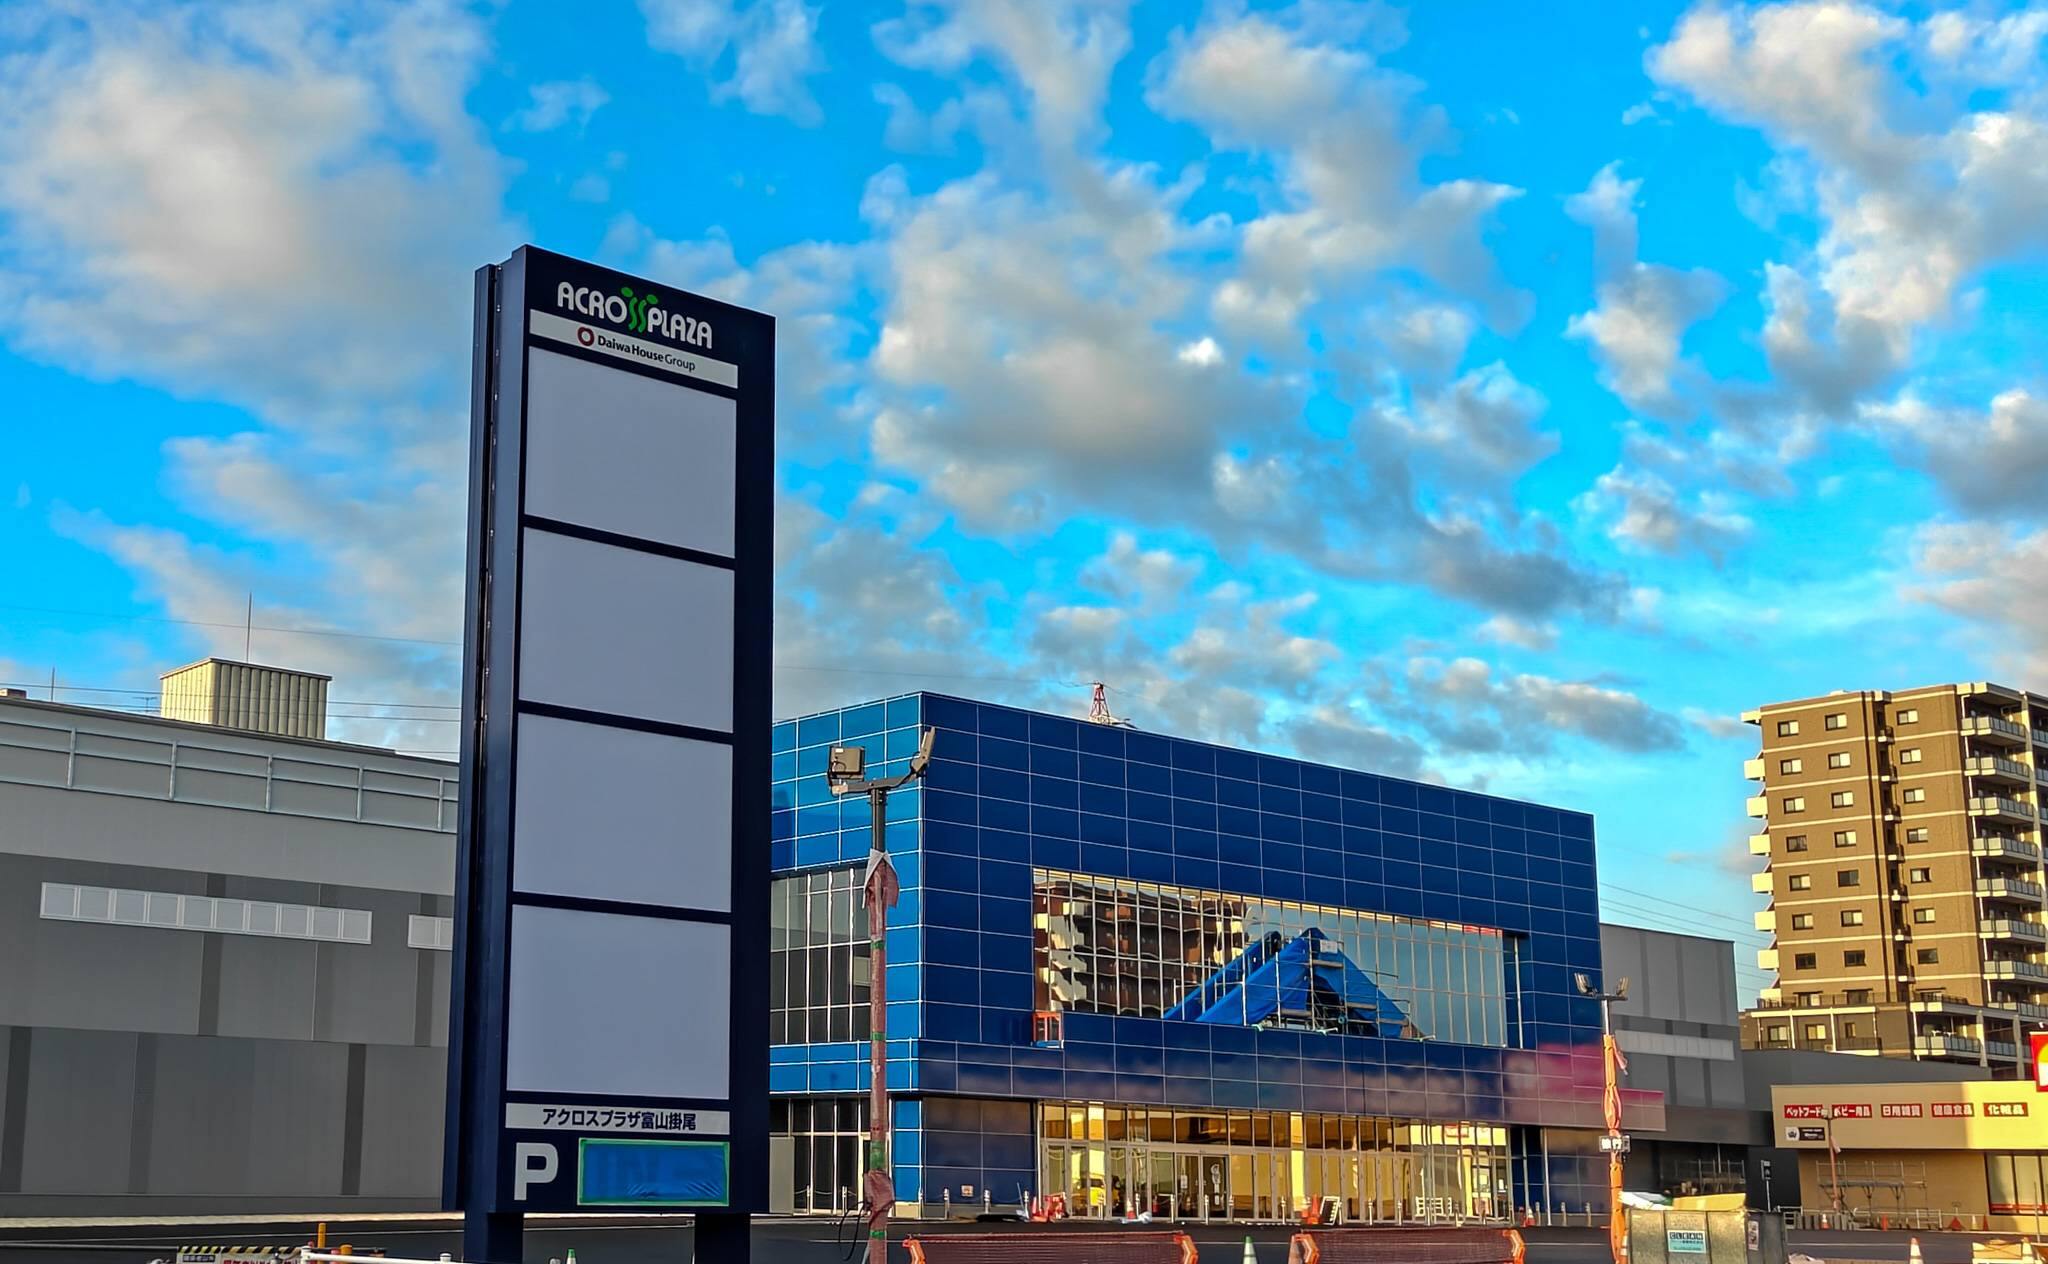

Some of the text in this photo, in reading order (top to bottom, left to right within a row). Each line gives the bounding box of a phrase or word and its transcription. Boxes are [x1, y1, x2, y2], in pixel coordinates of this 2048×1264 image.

[647, 307, 712, 349] PLAZA
[665, 354, 696, 372] Group
[543, 1108, 696, 1131] アクロスプラザ富山掛尾
[514, 1142, 559, 1201] P
